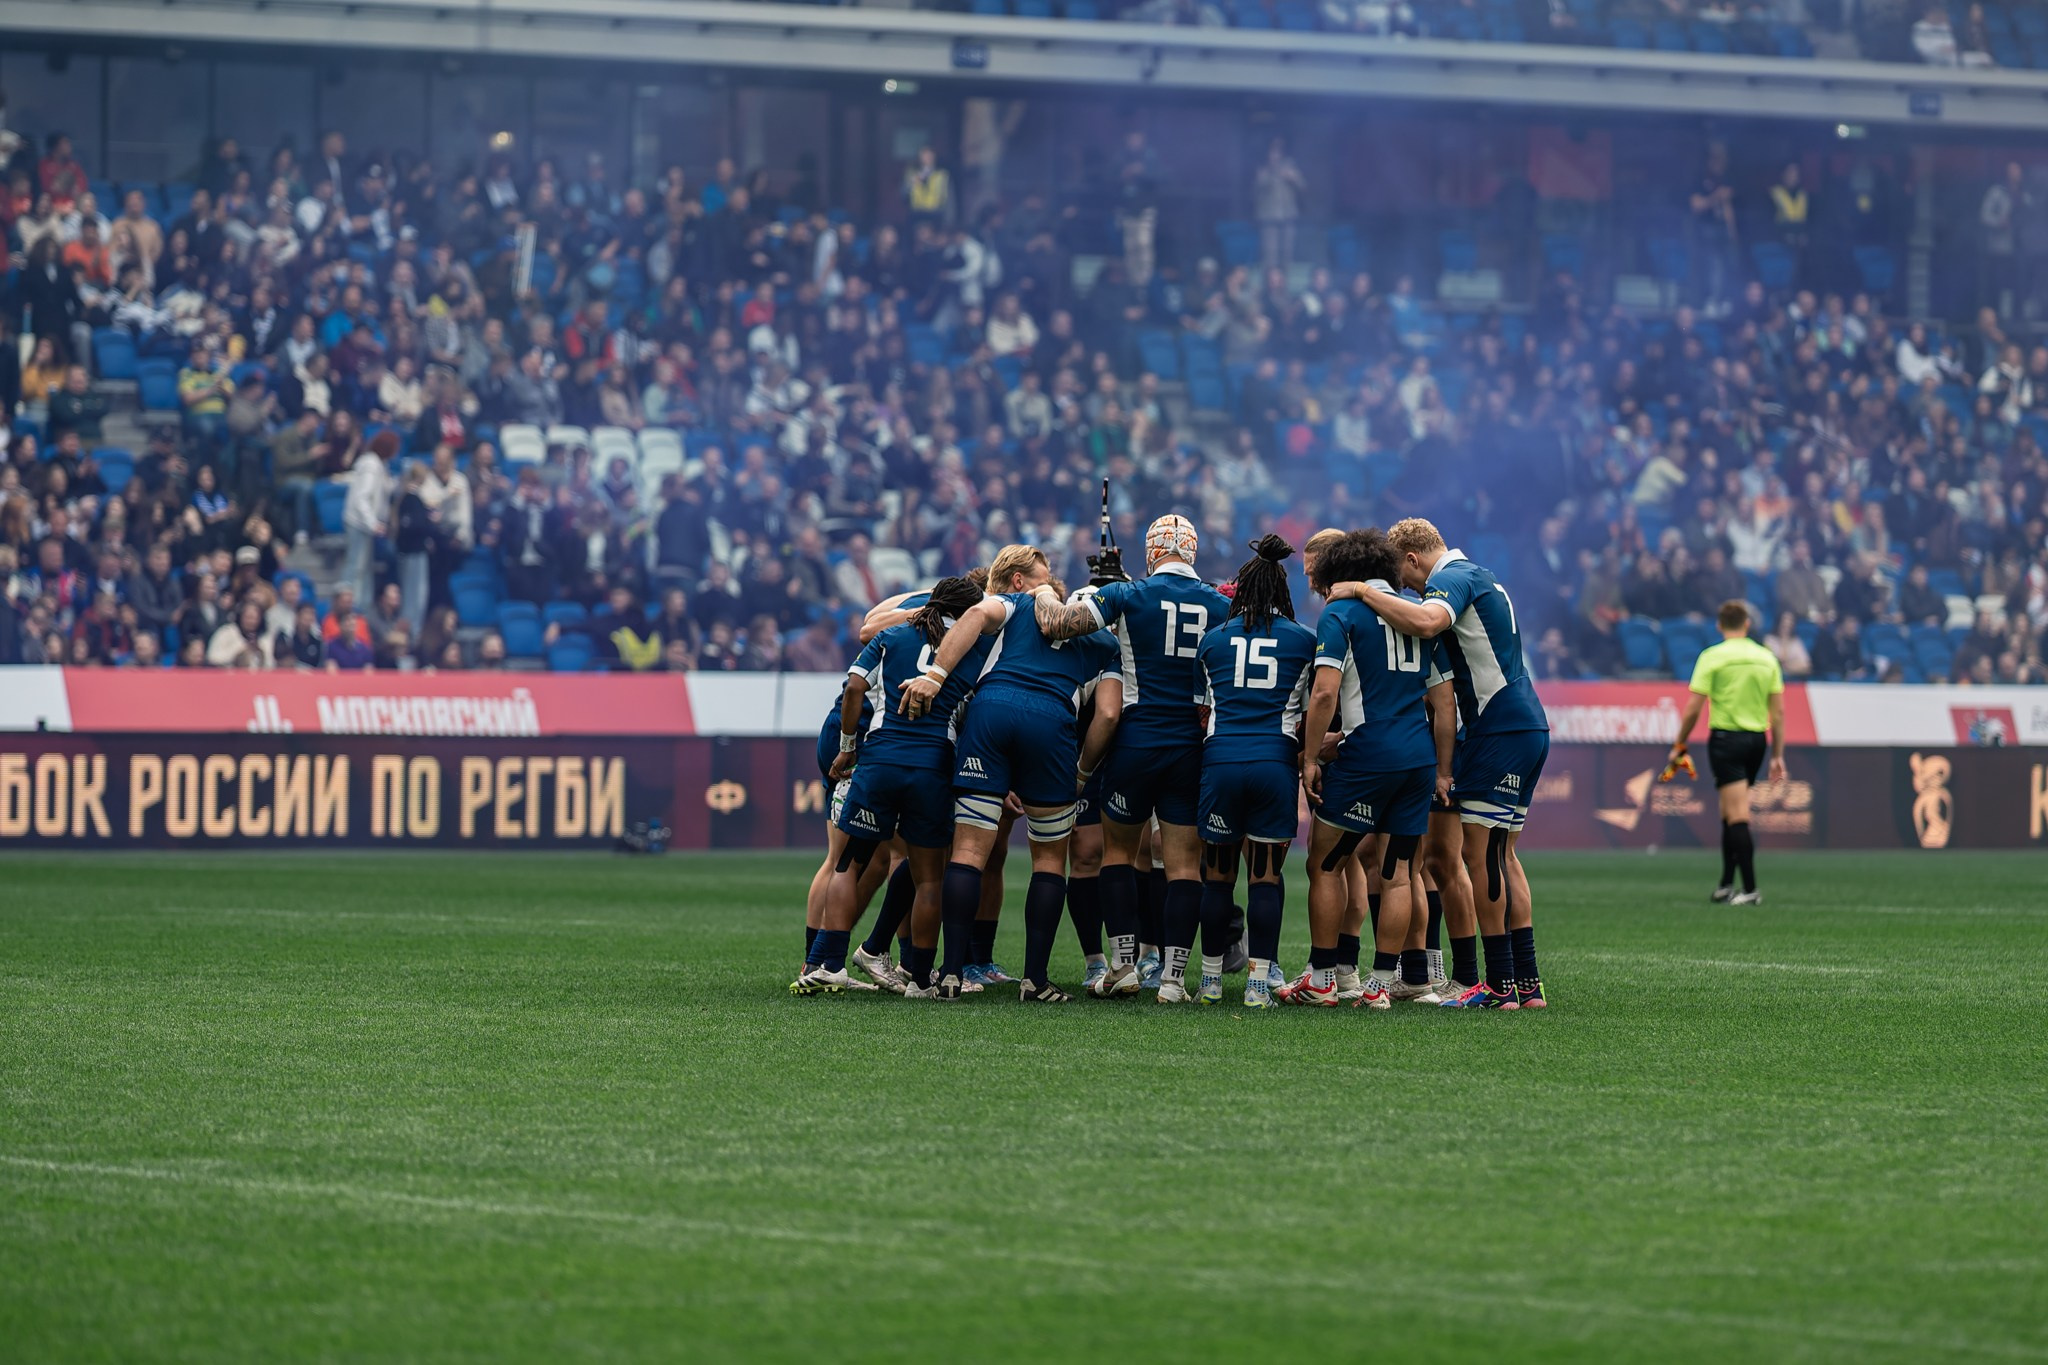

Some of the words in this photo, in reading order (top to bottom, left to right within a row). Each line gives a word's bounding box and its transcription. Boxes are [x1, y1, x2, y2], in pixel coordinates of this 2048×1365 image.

[1160, 600, 1208, 658] 13
[1376, 616, 1421, 673] 10
[1230, 636, 1279, 690] 15
[315, 687, 541, 736] МОСКОВСКИЙ
[0, 752, 113, 837] БОК
[129, 753, 350, 838] РОССИИ
[371, 753, 442, 838] ПО
[460, 755, 626, 838] РЕГБИ
